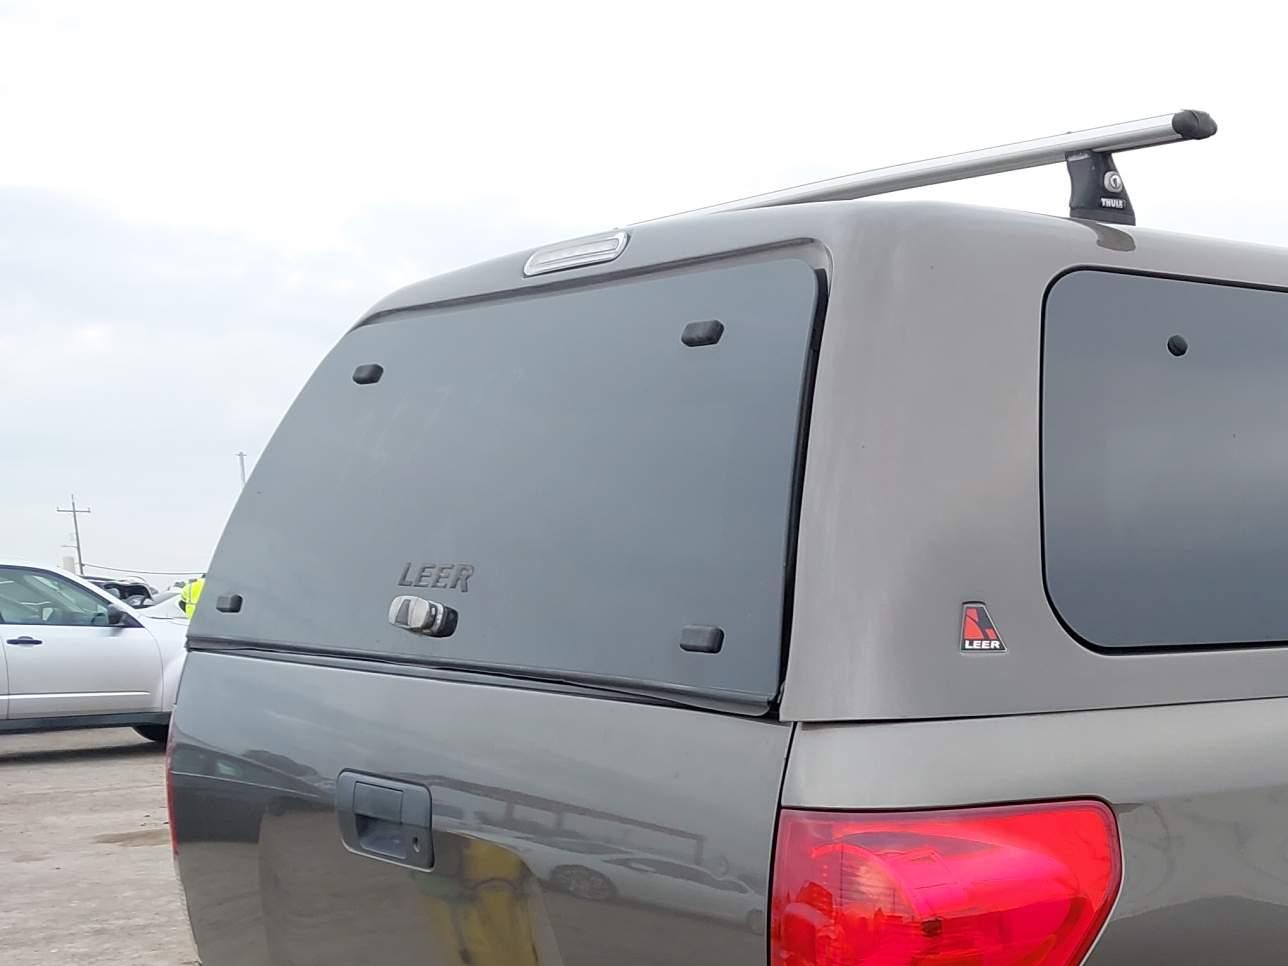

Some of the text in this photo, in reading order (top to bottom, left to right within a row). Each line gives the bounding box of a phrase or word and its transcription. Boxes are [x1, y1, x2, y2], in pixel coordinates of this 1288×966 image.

[1100, 197, 1124, 208] THULE
[397, 561, 475, 592] LEER
[964, 640, 1000, 649] LEER
